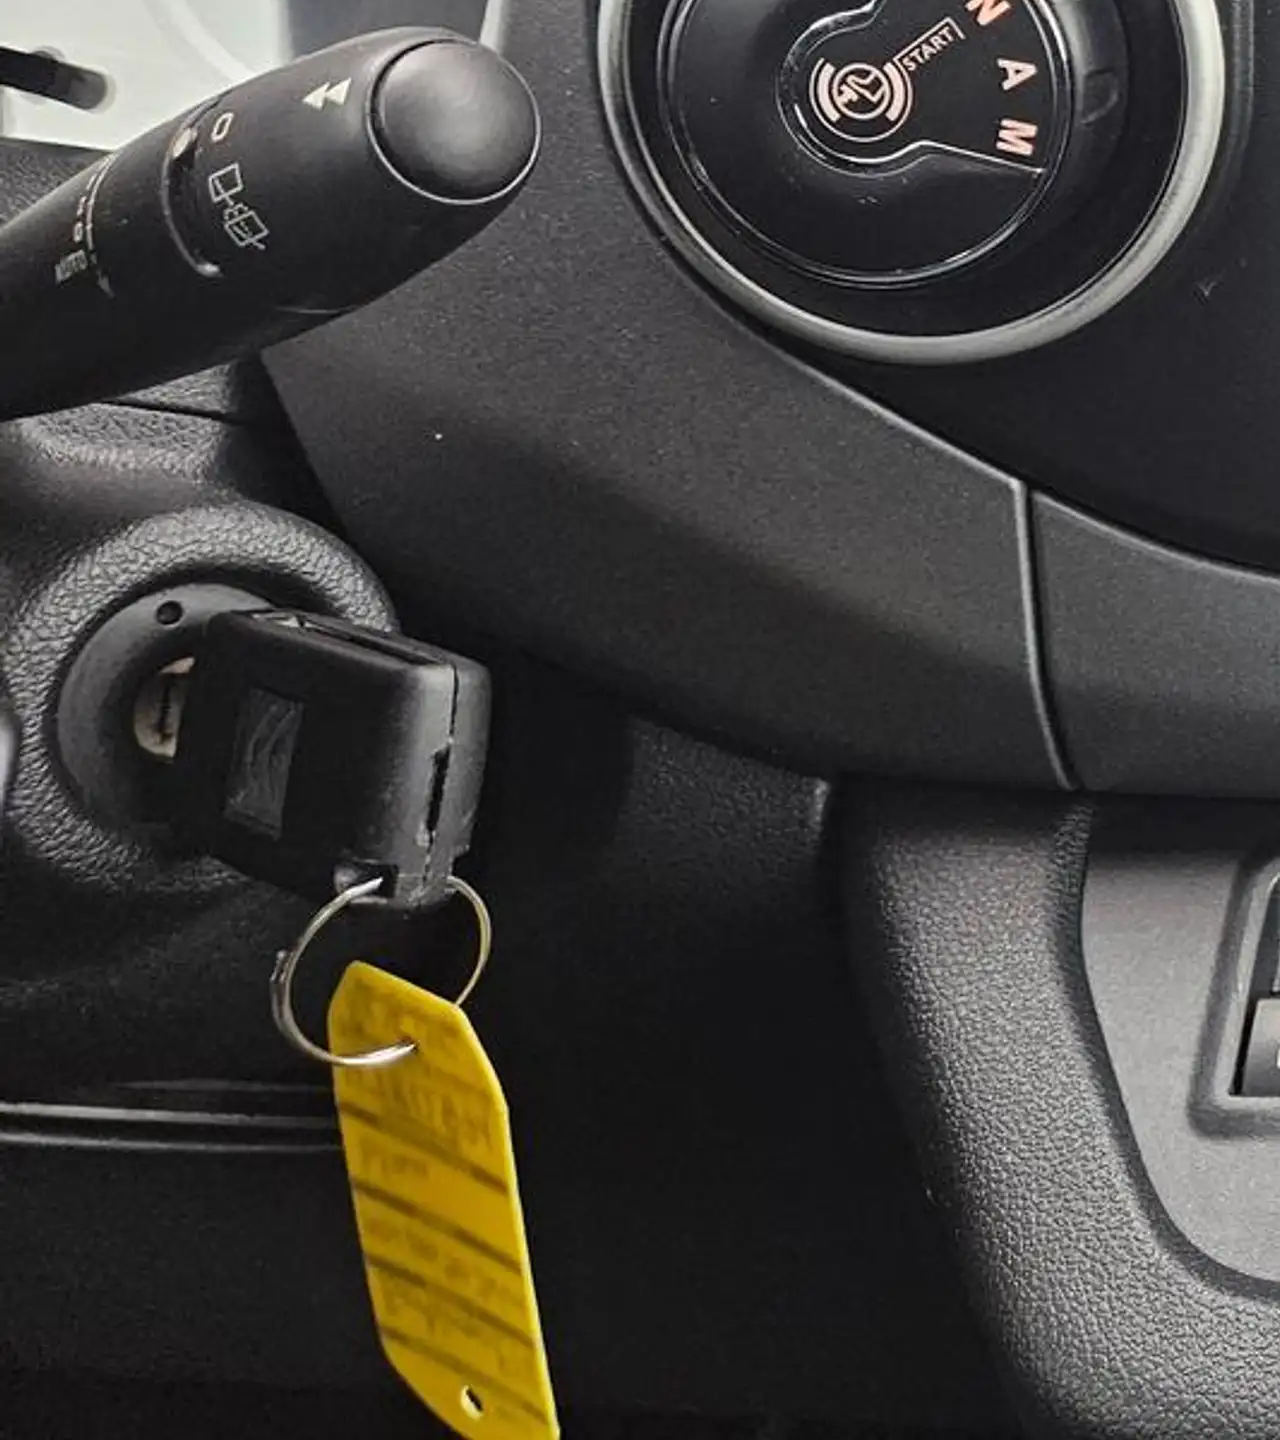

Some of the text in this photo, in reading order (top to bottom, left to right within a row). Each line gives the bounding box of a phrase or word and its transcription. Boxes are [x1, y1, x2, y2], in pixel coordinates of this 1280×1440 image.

[903, 26, 954, 71] START
[997, 58, 1037, 91] A
[995, 118, 1038, 156] M
